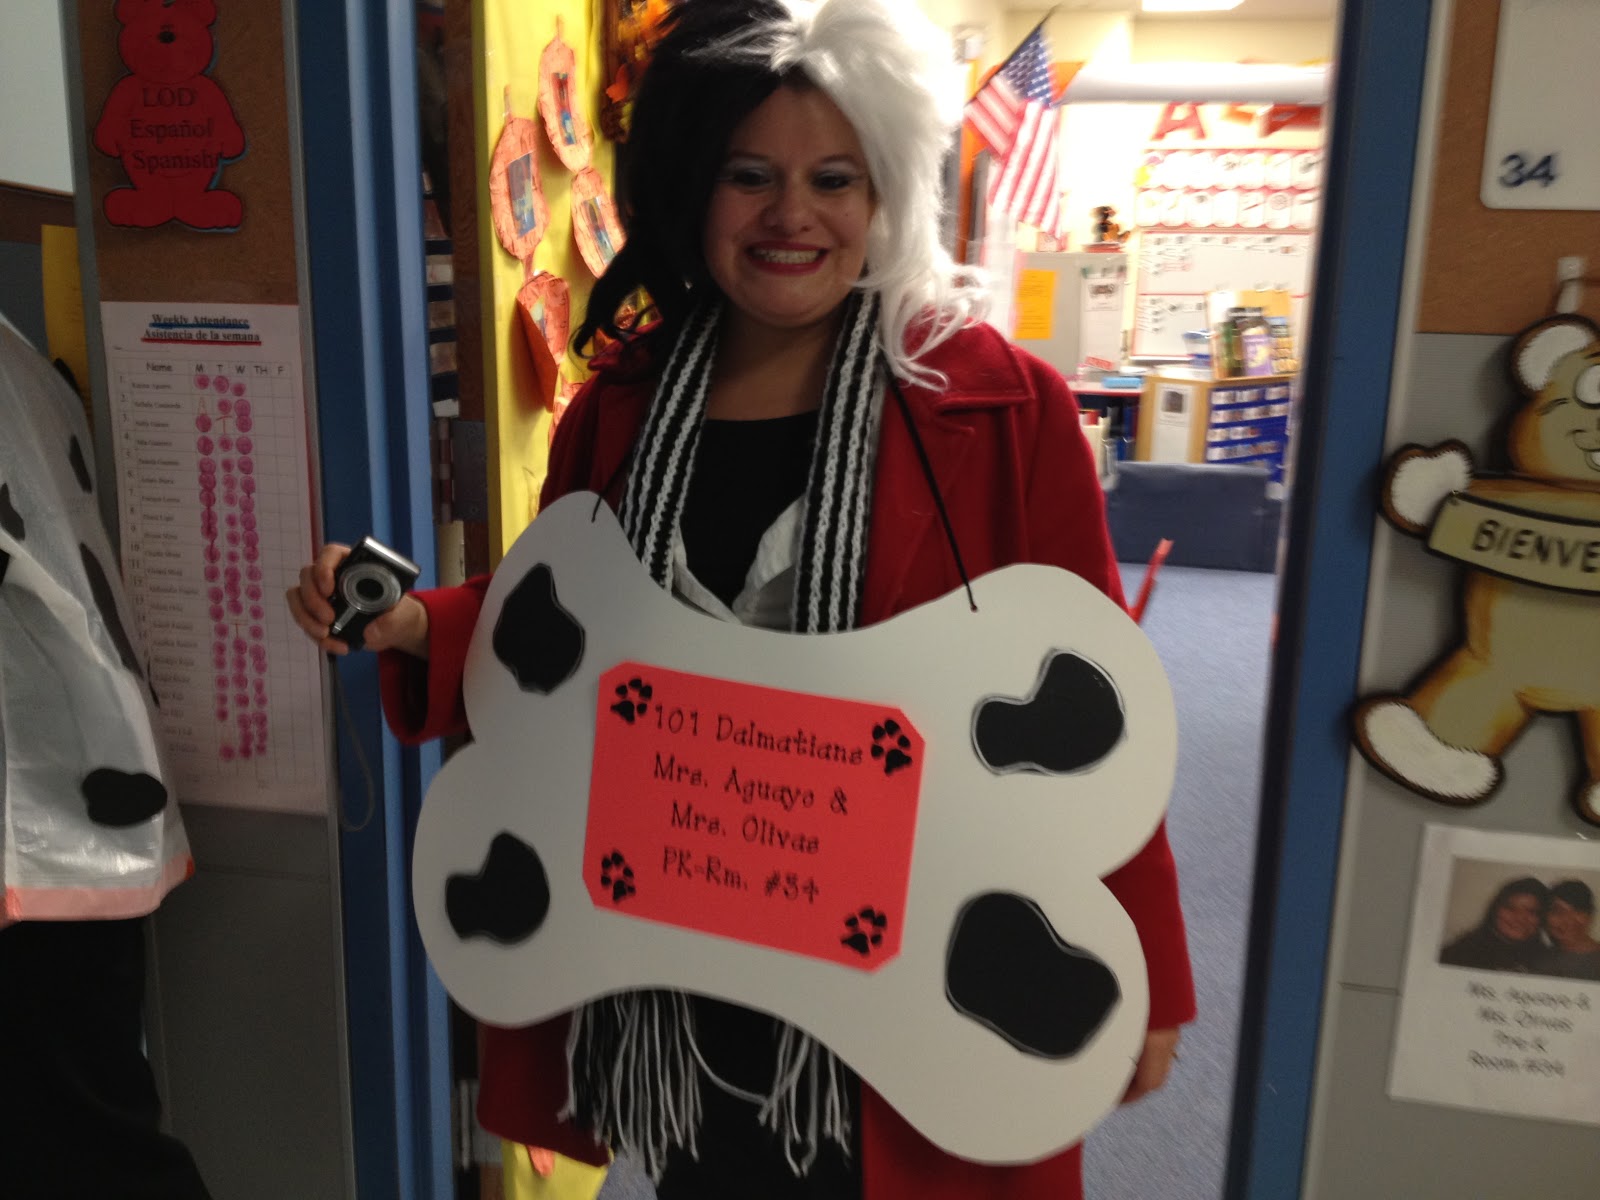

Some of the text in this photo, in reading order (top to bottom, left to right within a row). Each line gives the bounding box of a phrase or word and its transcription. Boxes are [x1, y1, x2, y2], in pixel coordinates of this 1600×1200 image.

[142, 87, 196, 107] LOD
[130, 117, 214, 144] Español
[132, 149, 216, 175] Spanish
[1498, 153, 1556, 189] 34
[152, 313, 249, 328] Weekly Attendance
[143, 329, 260, 343] Asistencia de la semana
[146, 362, 173, 373] Name
[195, 364, 204, 373] M
[216, 364, 224, 374] T
[236, 366, 246, 375] W
[254, 366, 268, 375] TH
[1472, 518, 1600, 574] BIENVE
[655, 704, 863, 766] 101 Dalmatians
[653, 752, 848, 815] Mrs. Aguayo &
[671, 801, 819, 855] Mrs. Olivas
